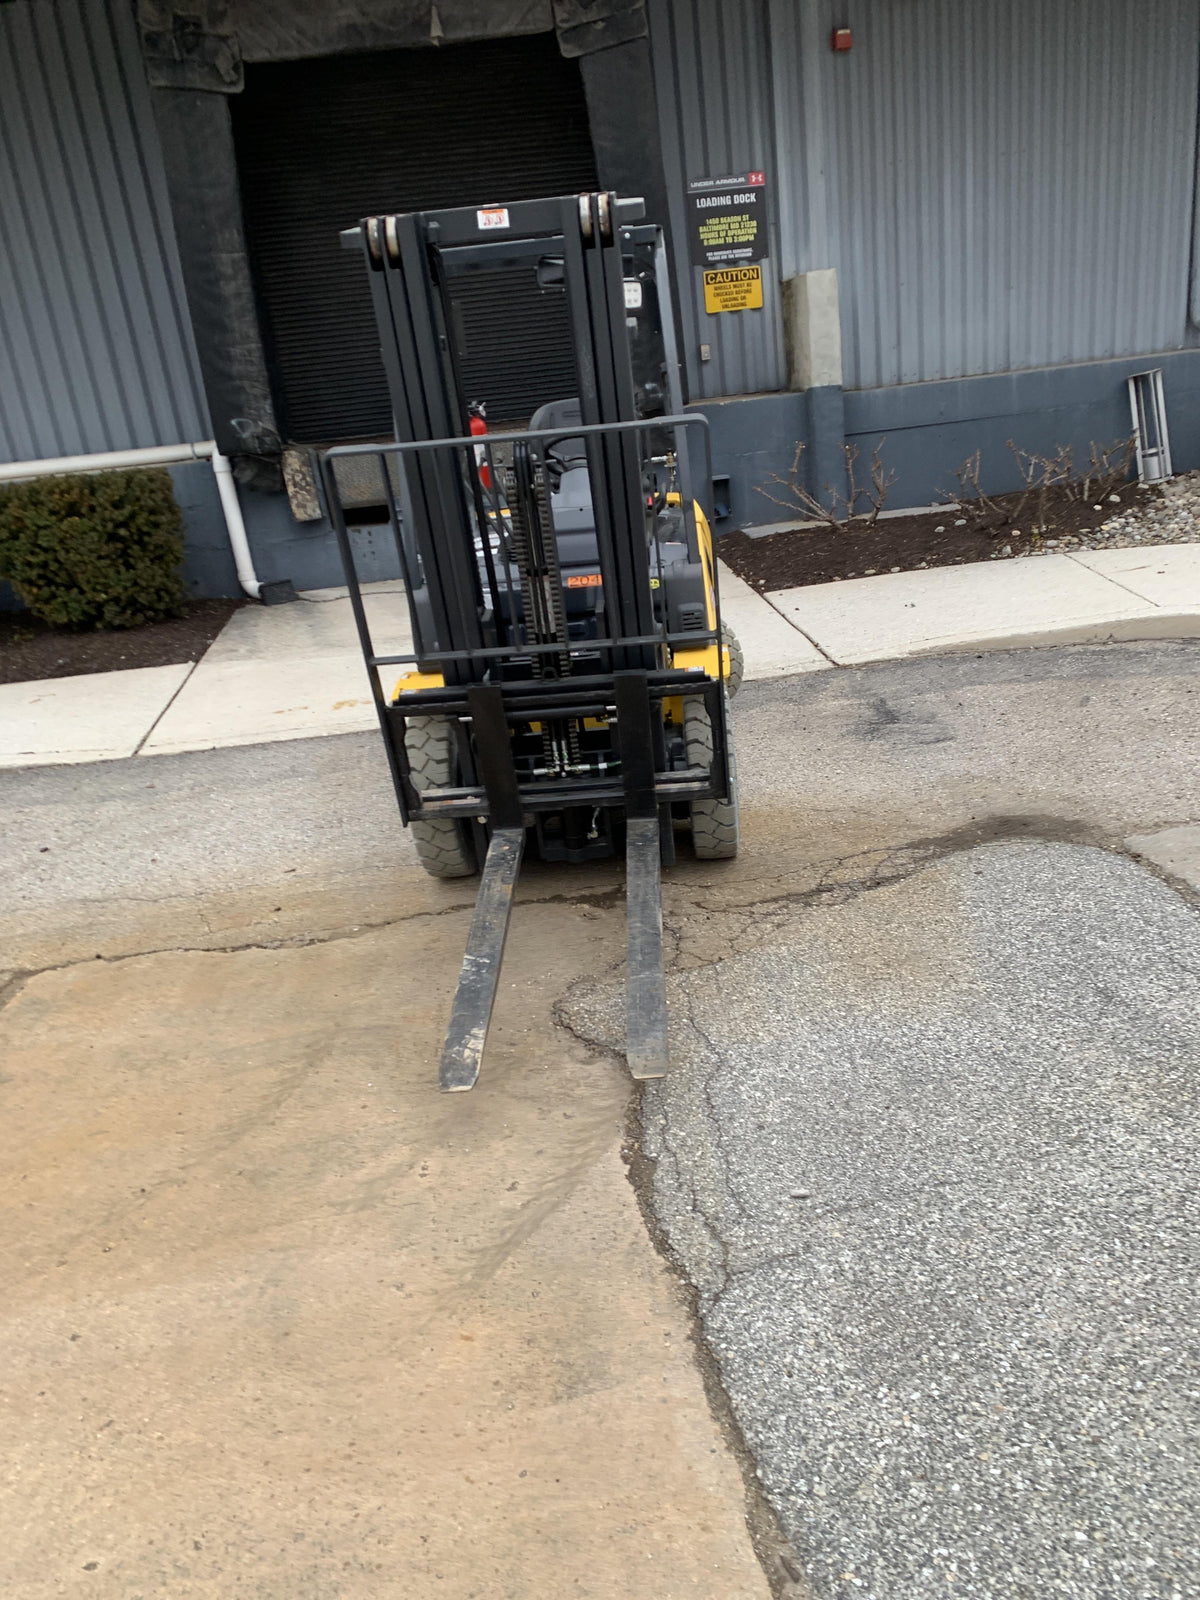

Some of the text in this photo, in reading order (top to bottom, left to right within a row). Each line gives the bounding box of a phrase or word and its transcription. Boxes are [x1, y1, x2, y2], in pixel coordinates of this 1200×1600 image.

[716, 177, 746, 186] ARMOUR
[696, 192, 756, 208] LOADING DOCK
[699, 223, 729, 232] BALTIMORE
[728, 227, 757, 236] OPERATION
[707, 269, 757, 284] CAUTION
[570, 574, 600, 587] 204
